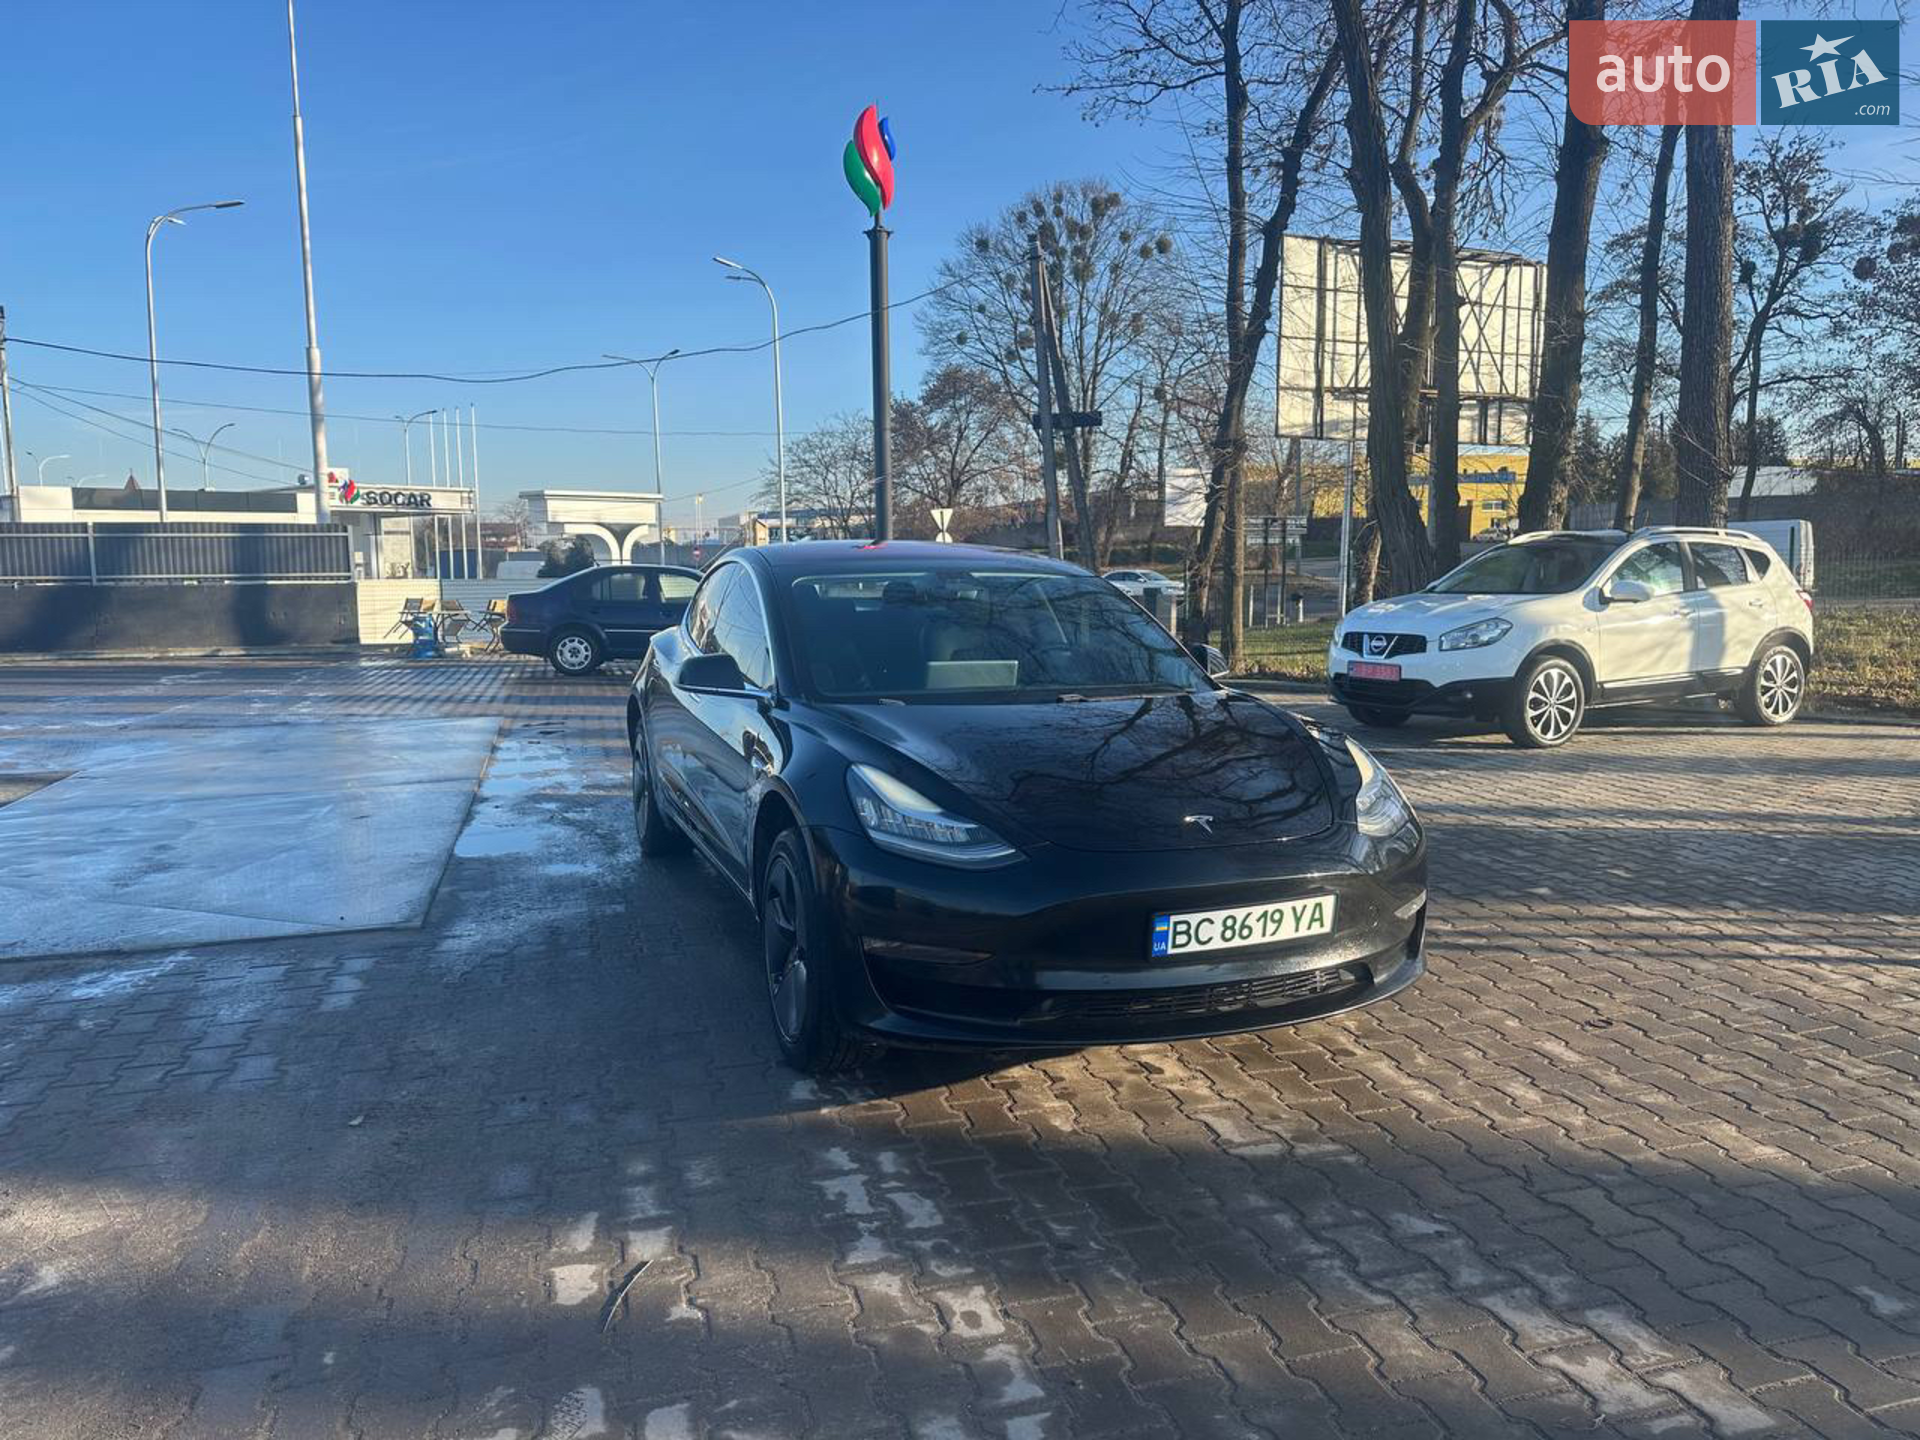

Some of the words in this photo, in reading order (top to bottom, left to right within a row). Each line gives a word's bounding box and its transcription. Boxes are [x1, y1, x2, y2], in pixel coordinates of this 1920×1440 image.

[364, 490, 432, 507] SOCAR
[1171, 917, 1215, 949] BC
[1220, 908, 1284, 943] 8619
[1291, 902, 1325, 933] YA
[1153, 941, 1167, 952] UA
